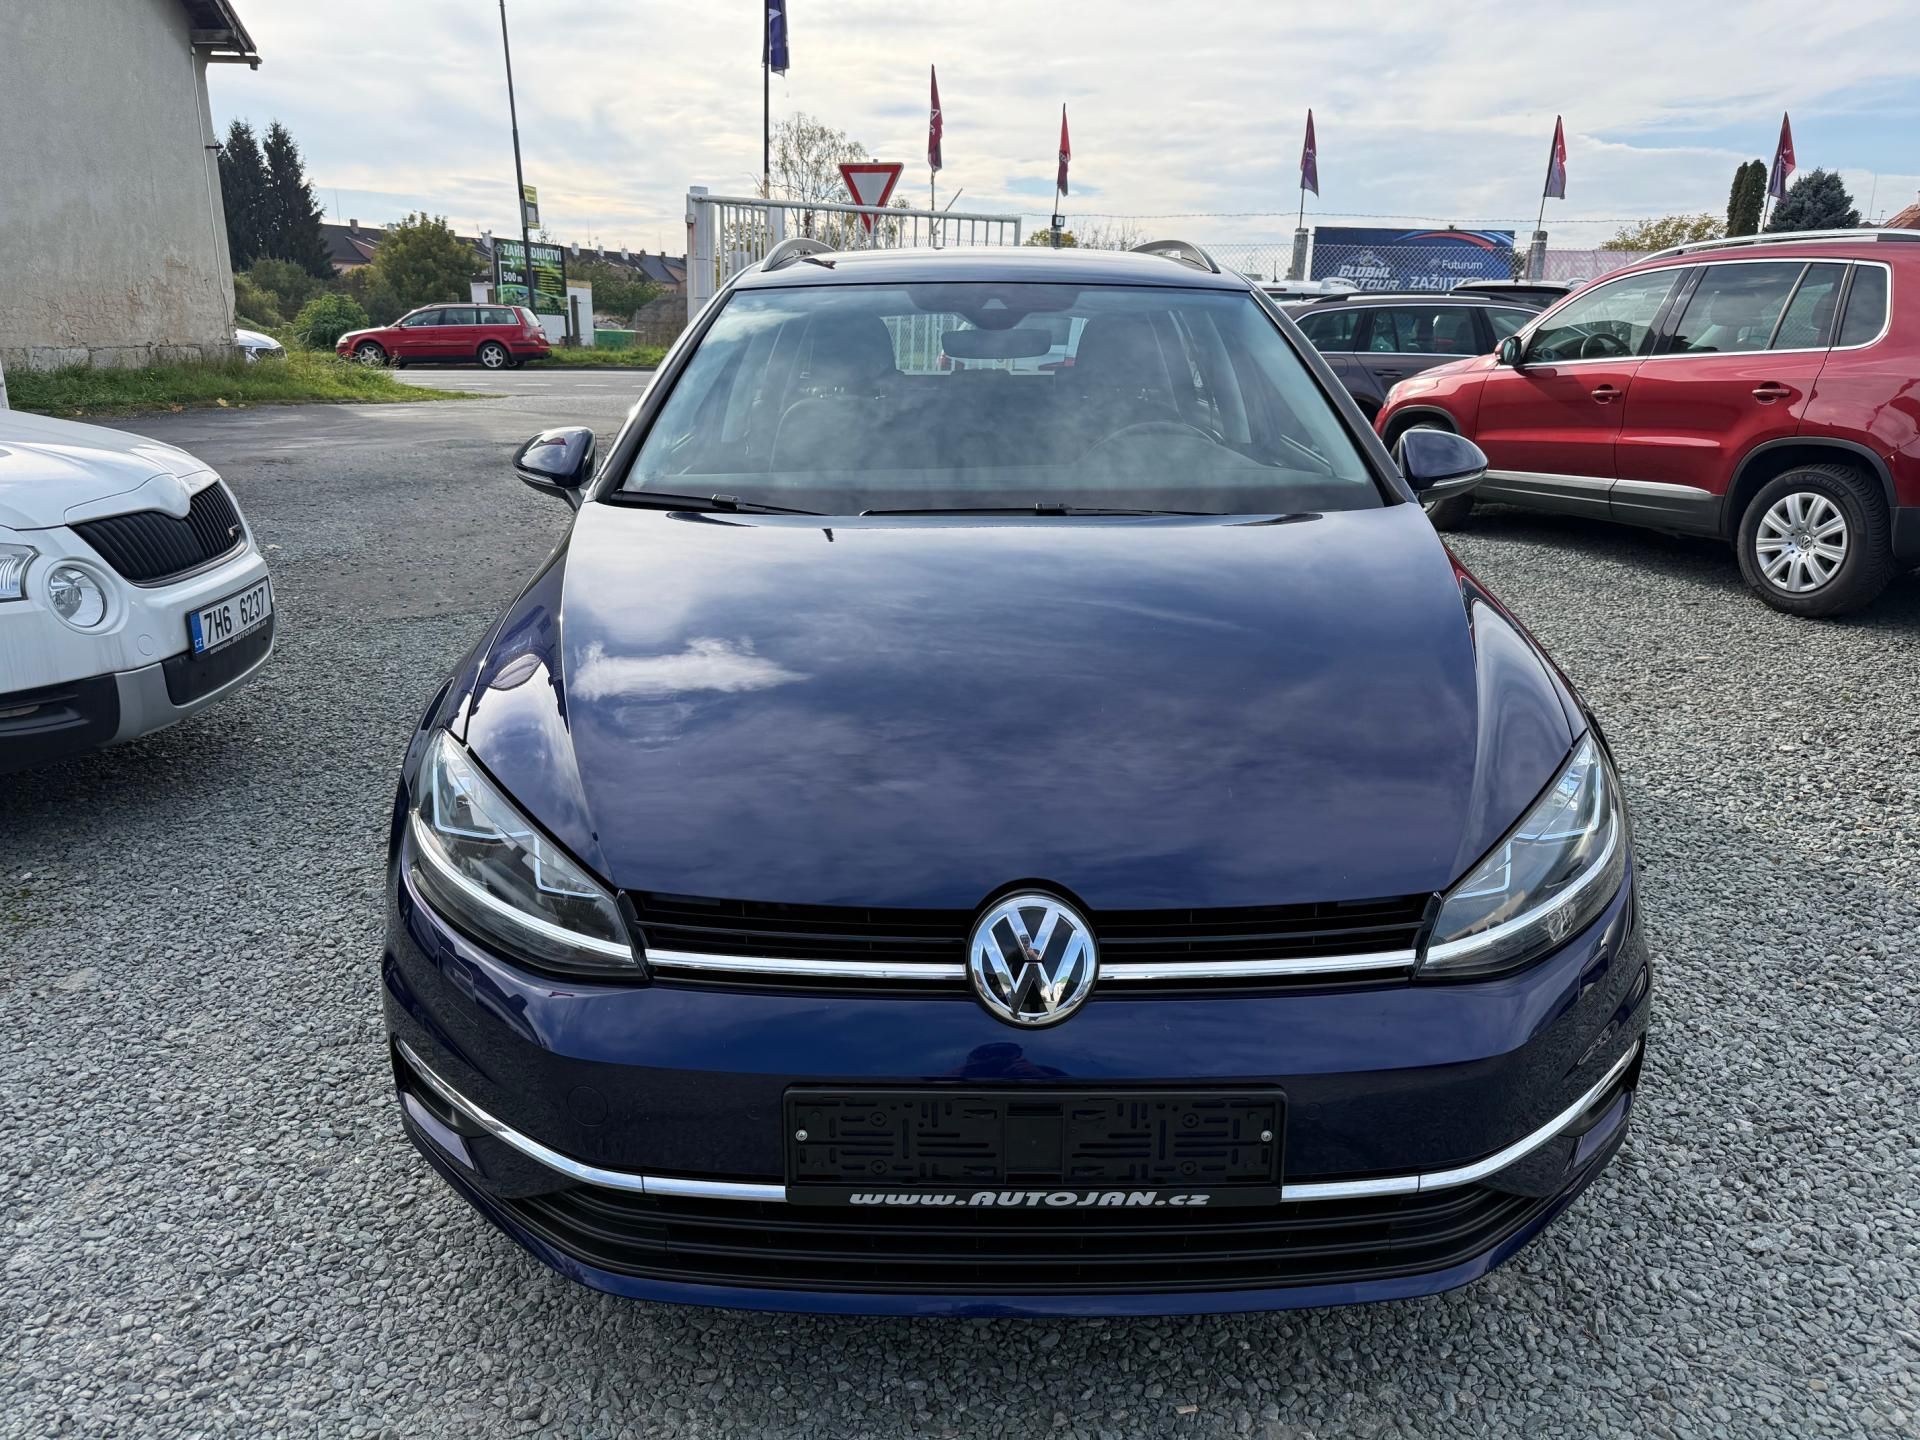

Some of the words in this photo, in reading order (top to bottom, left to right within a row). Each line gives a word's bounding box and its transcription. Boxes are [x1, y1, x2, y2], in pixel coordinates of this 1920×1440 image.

[503, 244, 561, 261] ZAHRDNICTVÍ
[1338, 265, 1391, 278] GLOBAL
[1442, 260, 1483, 270] Futurum
[503, 272, 516, 282] 500
[204, 606, 232, 643] 7H6
[240, 587, 264, 624] 6237
[850, 1191, 1210, 1206] www.AUTOJAN.cz
